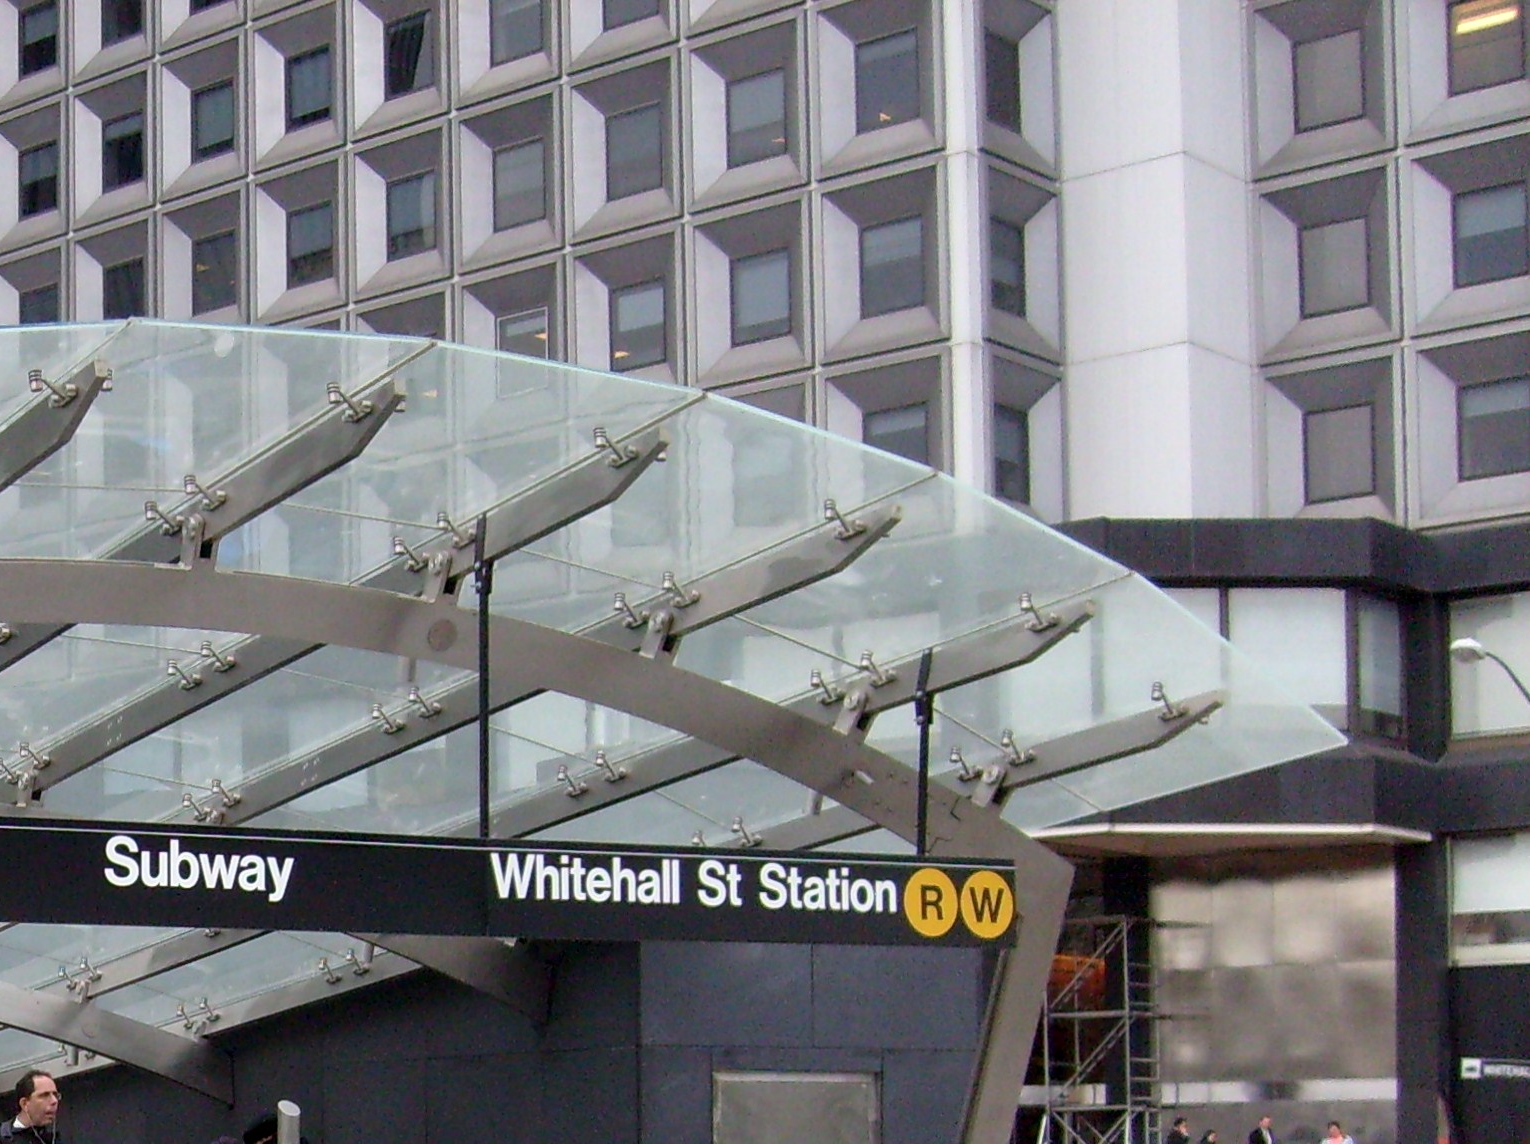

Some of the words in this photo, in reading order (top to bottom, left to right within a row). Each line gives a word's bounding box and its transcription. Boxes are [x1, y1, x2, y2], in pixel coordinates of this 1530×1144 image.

[104, 835, 295, 902] Subway
[490, 852, 680, 904] Whitehall
[697, 859, 743, 907] St
[759, 862, 898, 913] Station
[920, 884, 944, 921] R
[969, 886, 1005, 924] W
